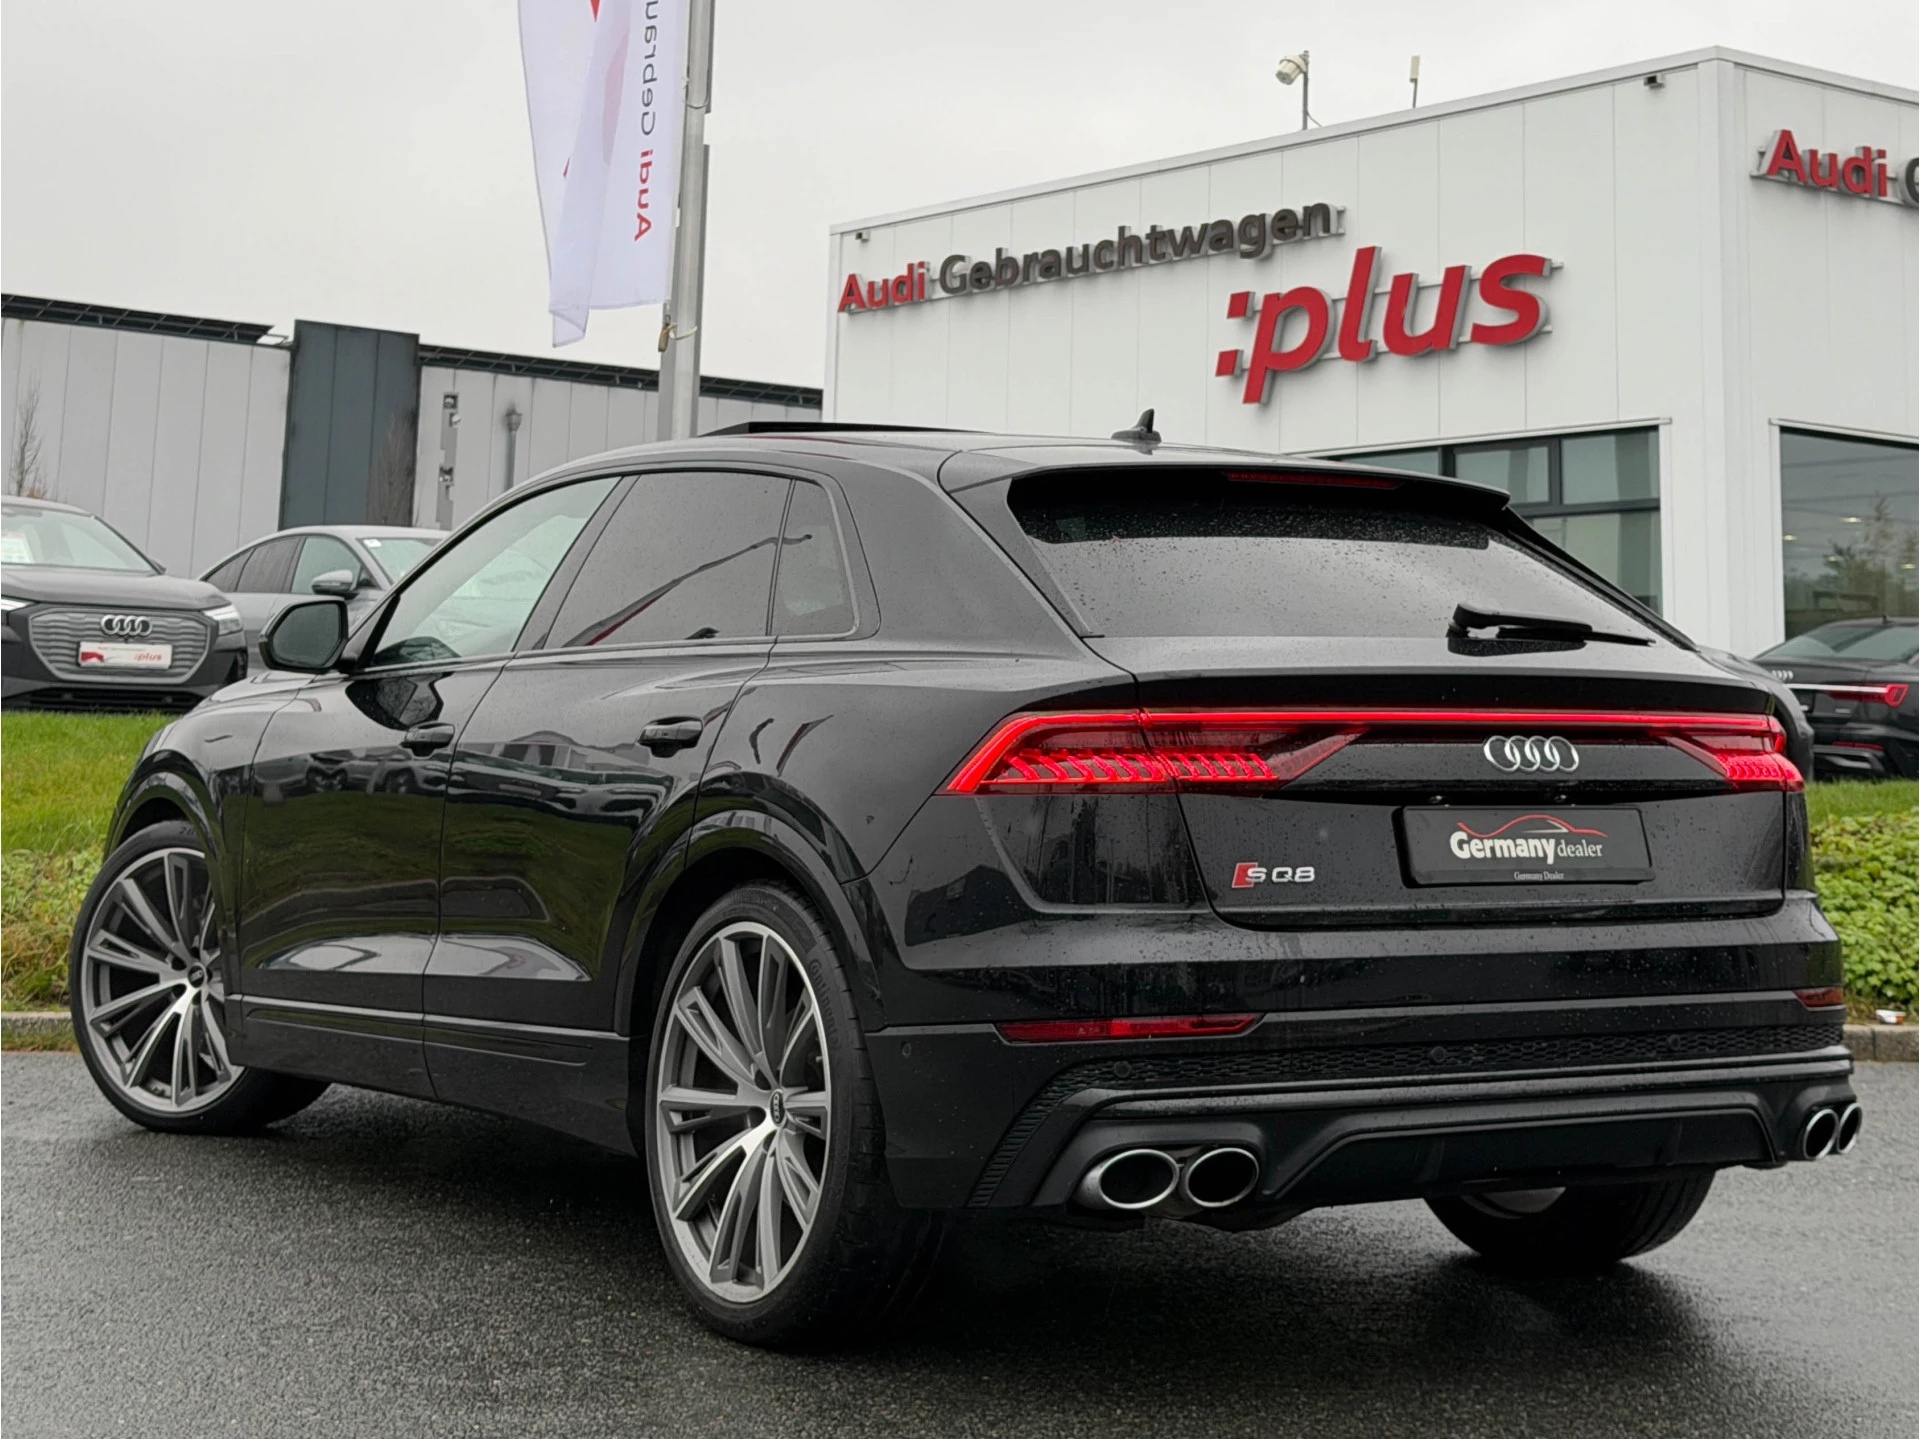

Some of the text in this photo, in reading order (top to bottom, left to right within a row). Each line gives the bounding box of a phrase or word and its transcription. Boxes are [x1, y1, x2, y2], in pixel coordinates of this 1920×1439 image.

[1766, 129, 1888, 197] Audi
[838, 201, 1332, 312] Audi Gebrauchtwagen
[1450, 830, 1603, 865] Germany dealer
[1513, 871, 1565, 881] Germany Dealer
